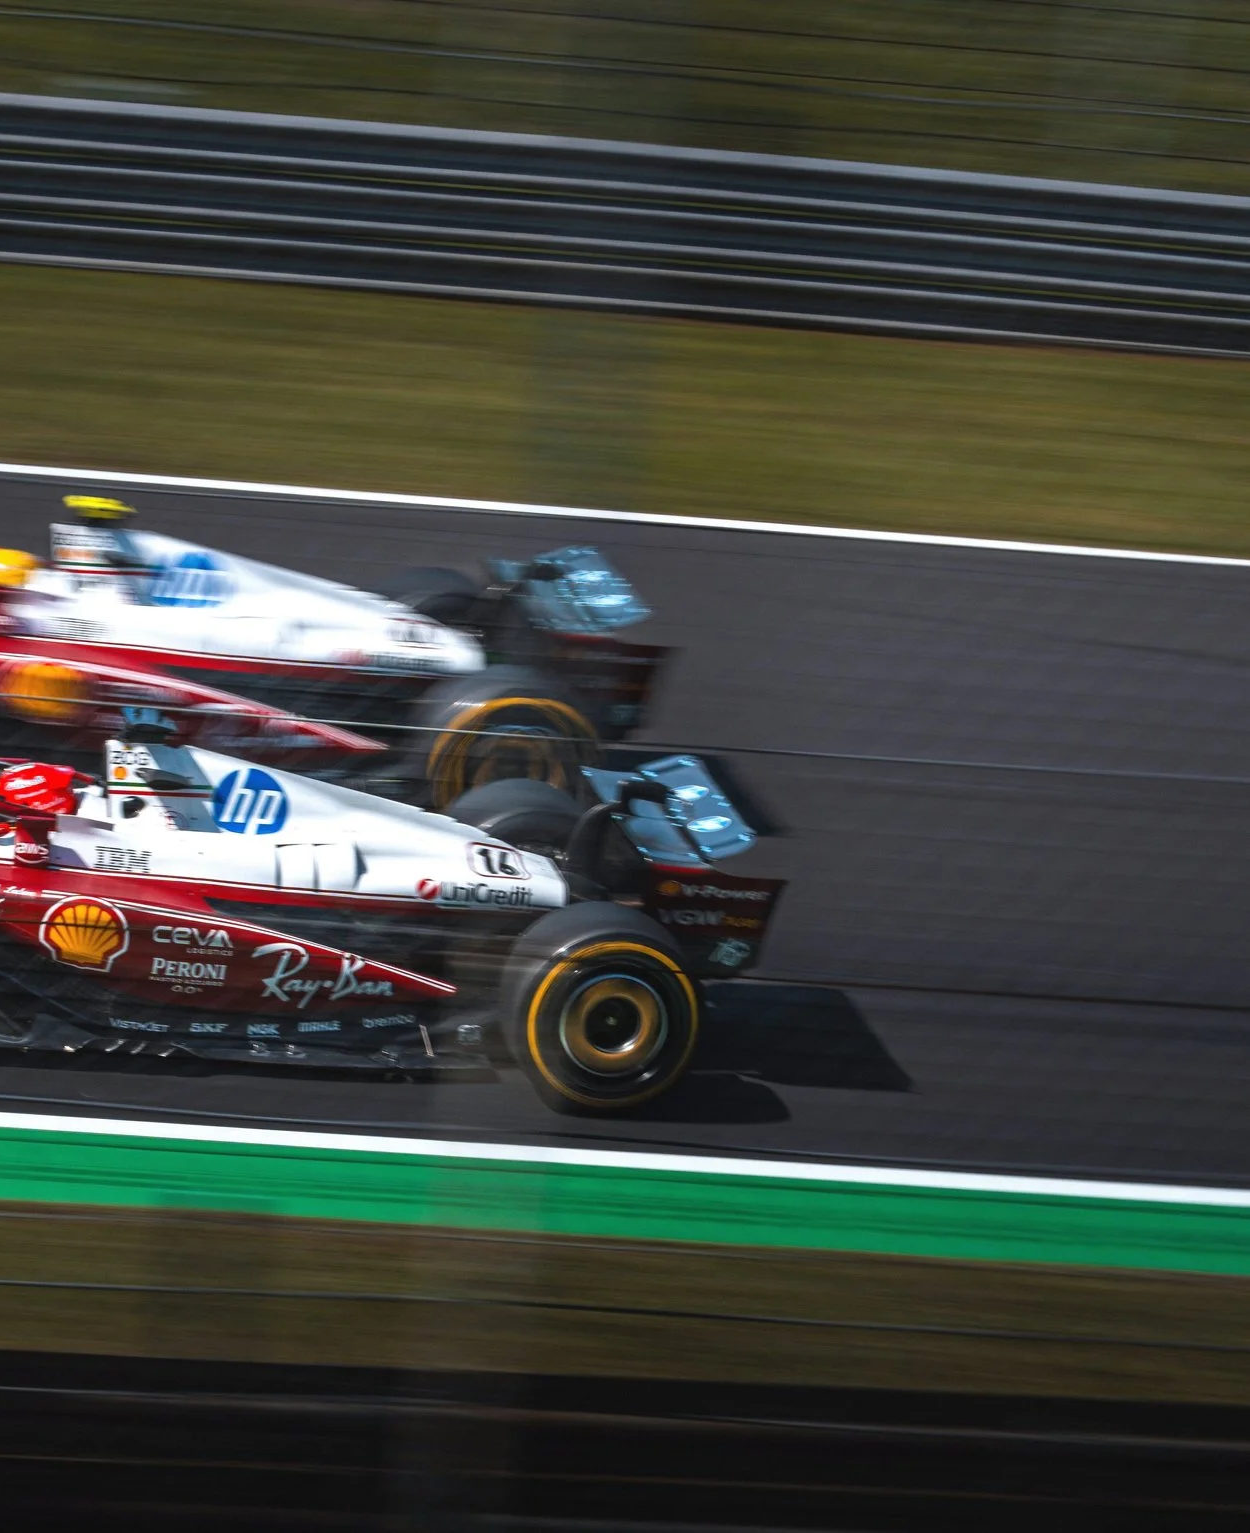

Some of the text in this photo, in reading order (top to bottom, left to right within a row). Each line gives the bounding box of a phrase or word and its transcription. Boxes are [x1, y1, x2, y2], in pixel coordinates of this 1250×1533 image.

[218, 768, 284, 835] hp
[15, 843, 49, 855] aws
[94, 846, 151, 873] IBM
[477, 848, 520, 876] 16
[440, 880, 533, 908] UniCredit
[150, 957, 227, 980] PERONI
[189, 1022, 229, 1033] SKF
